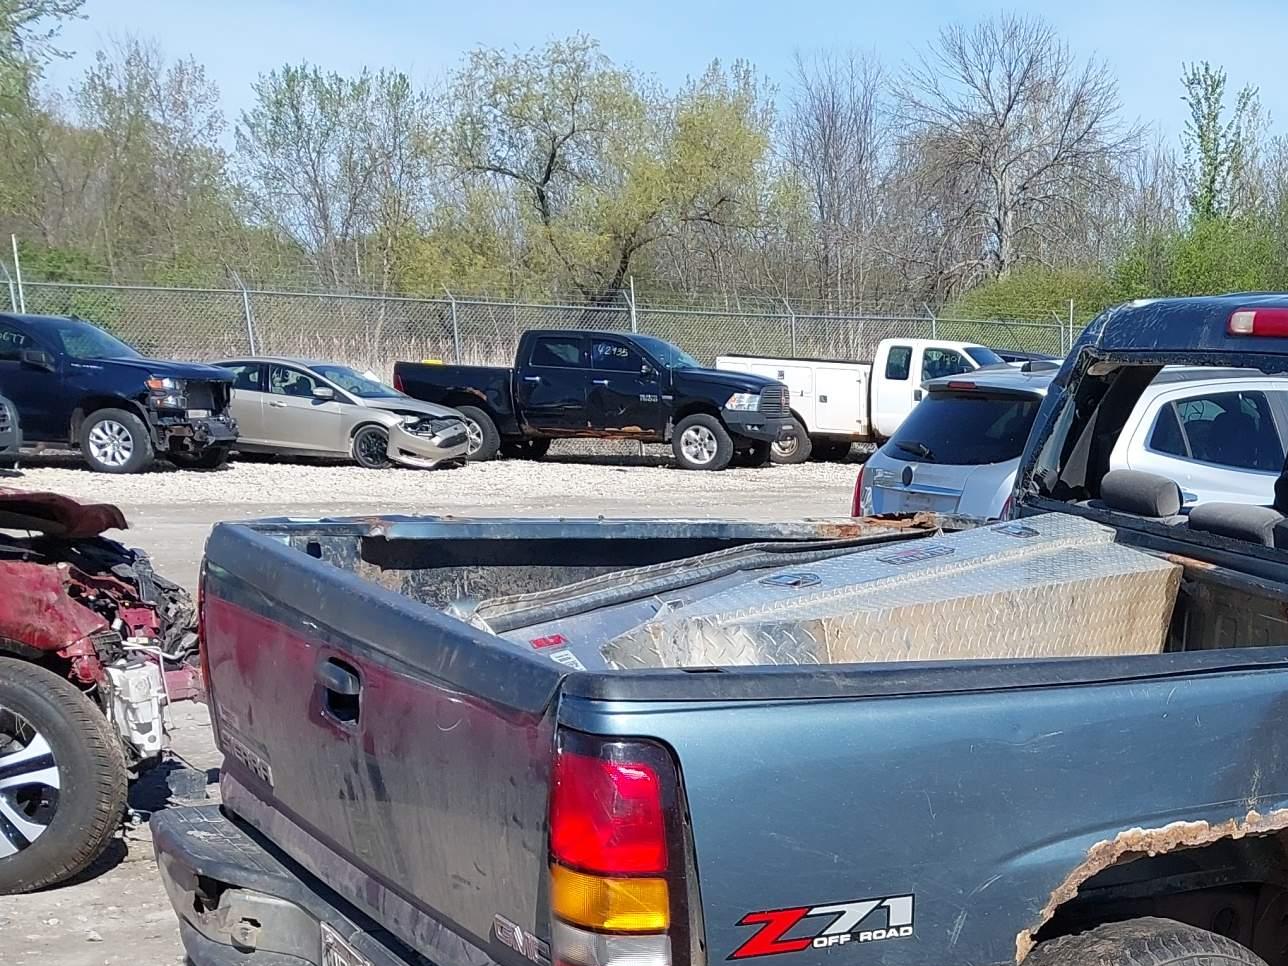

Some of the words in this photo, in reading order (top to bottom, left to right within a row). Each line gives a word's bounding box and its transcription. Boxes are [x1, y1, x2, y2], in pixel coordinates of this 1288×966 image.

[726, 894, 915, 961] Z71
[812, 933, 852, 950] OFF
[859, 926, 914, 943] ROAD
